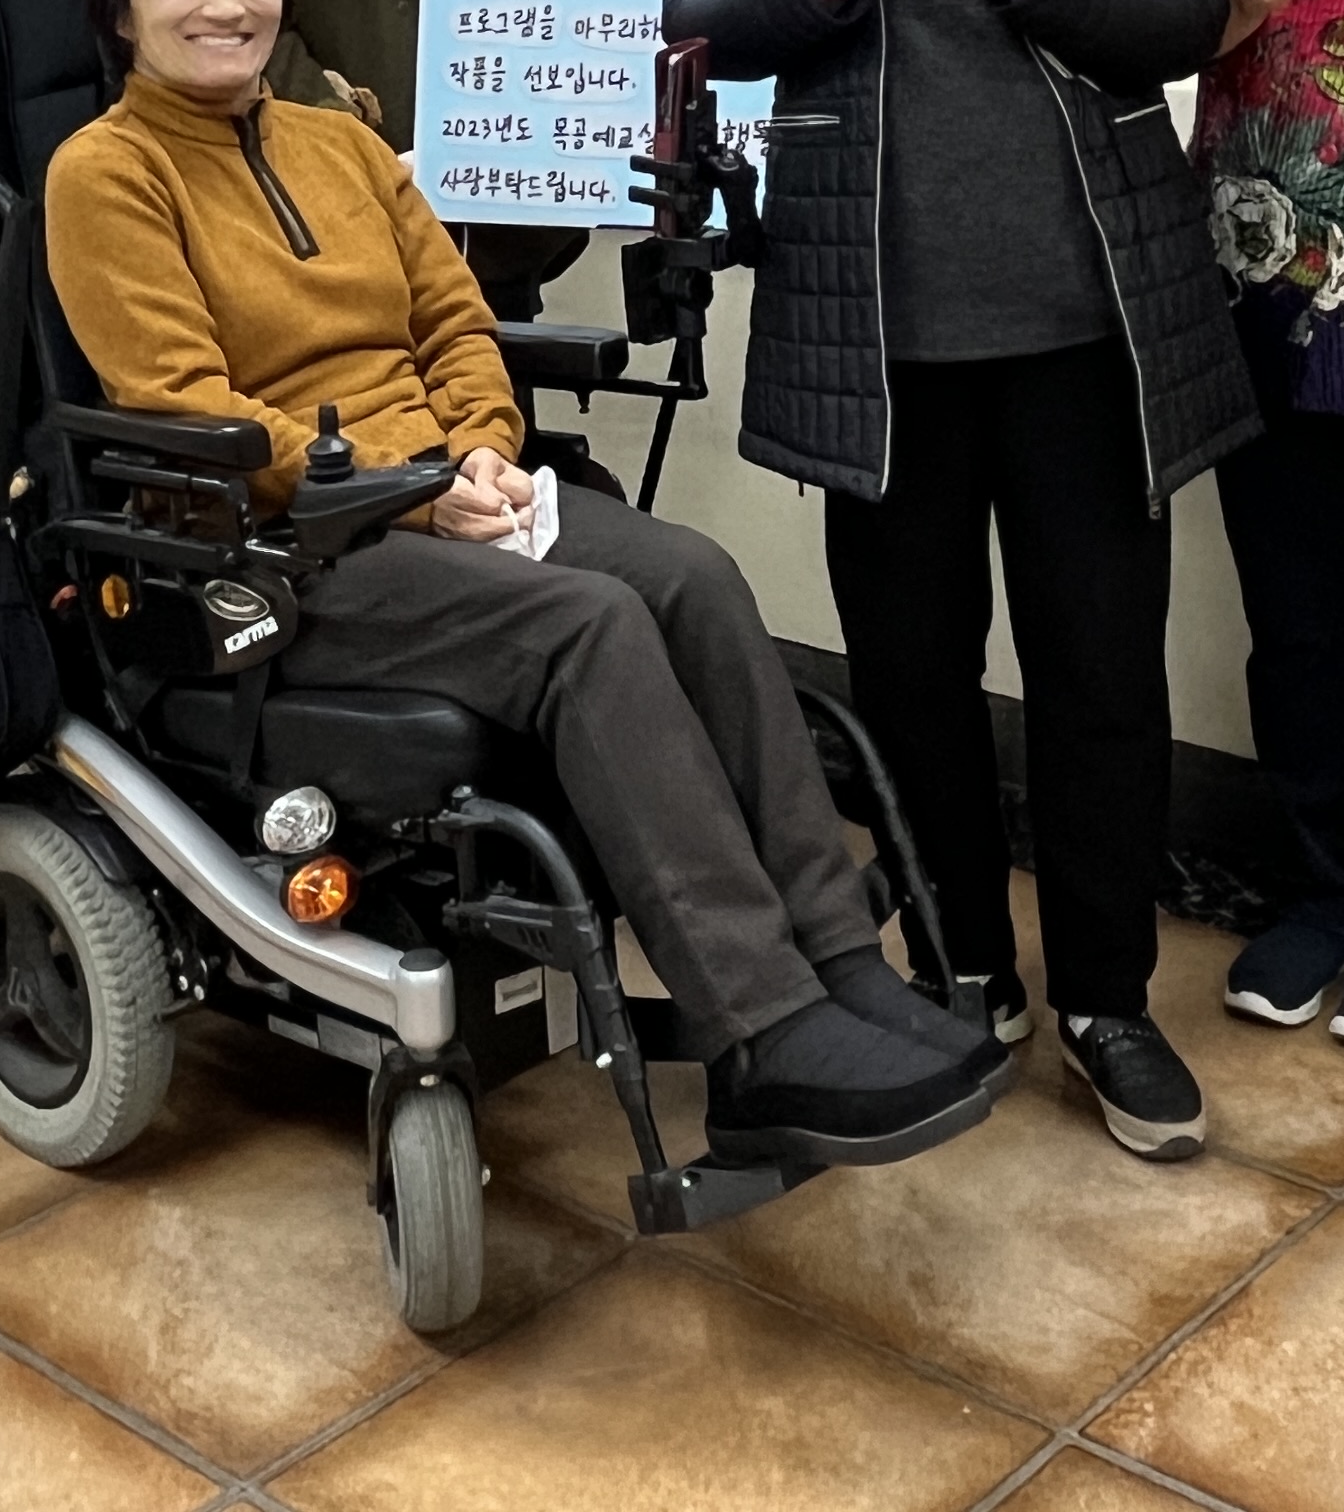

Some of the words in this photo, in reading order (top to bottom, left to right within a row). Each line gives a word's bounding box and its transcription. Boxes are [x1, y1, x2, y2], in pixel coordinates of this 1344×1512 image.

[457, 3, 556, 41] 프로그램을
[449, 55, 506, 93] 작품을
[523, 62, 637, 95] 선보입니다.
[442, 114, 533, 143] 2023년도
